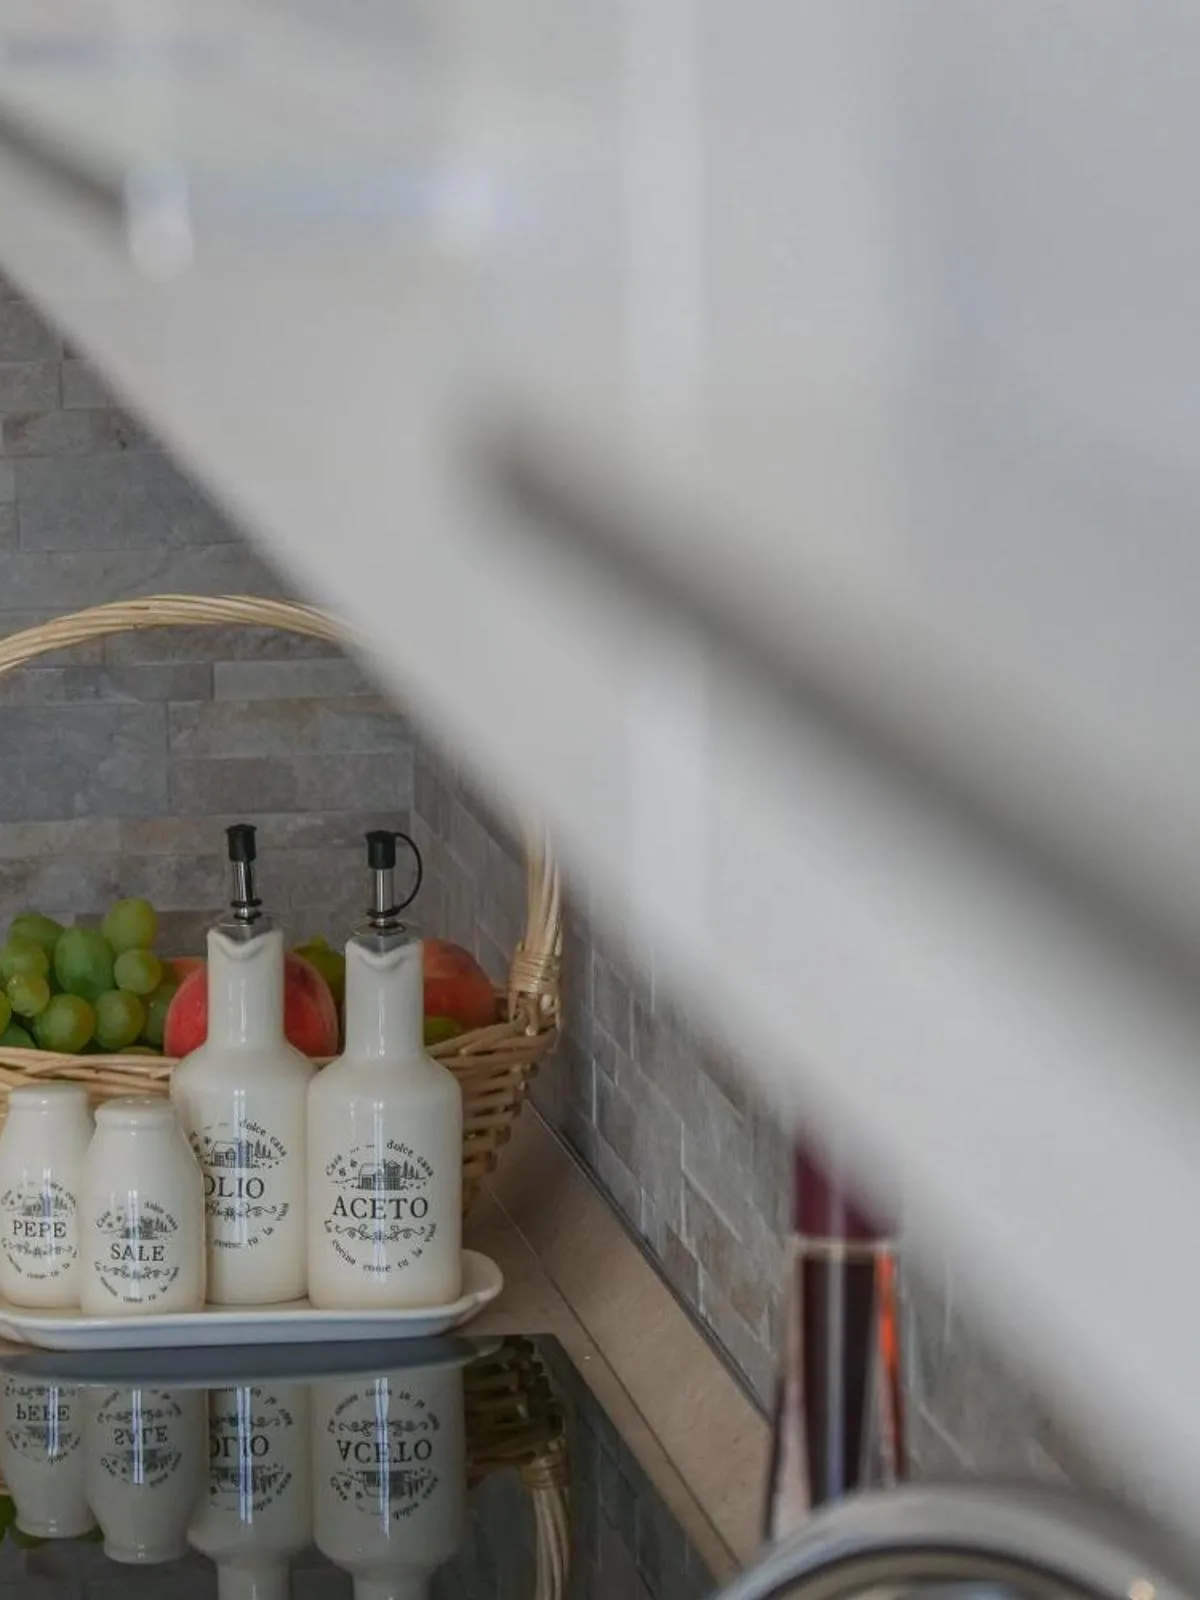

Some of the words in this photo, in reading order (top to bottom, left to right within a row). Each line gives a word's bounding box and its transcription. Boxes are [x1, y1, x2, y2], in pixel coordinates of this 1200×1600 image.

[332, 1195, 429, 1220] ACETO
[13, 1220, 67, 1238] PEPE
[110, 1243, 166, 1261] SALE
